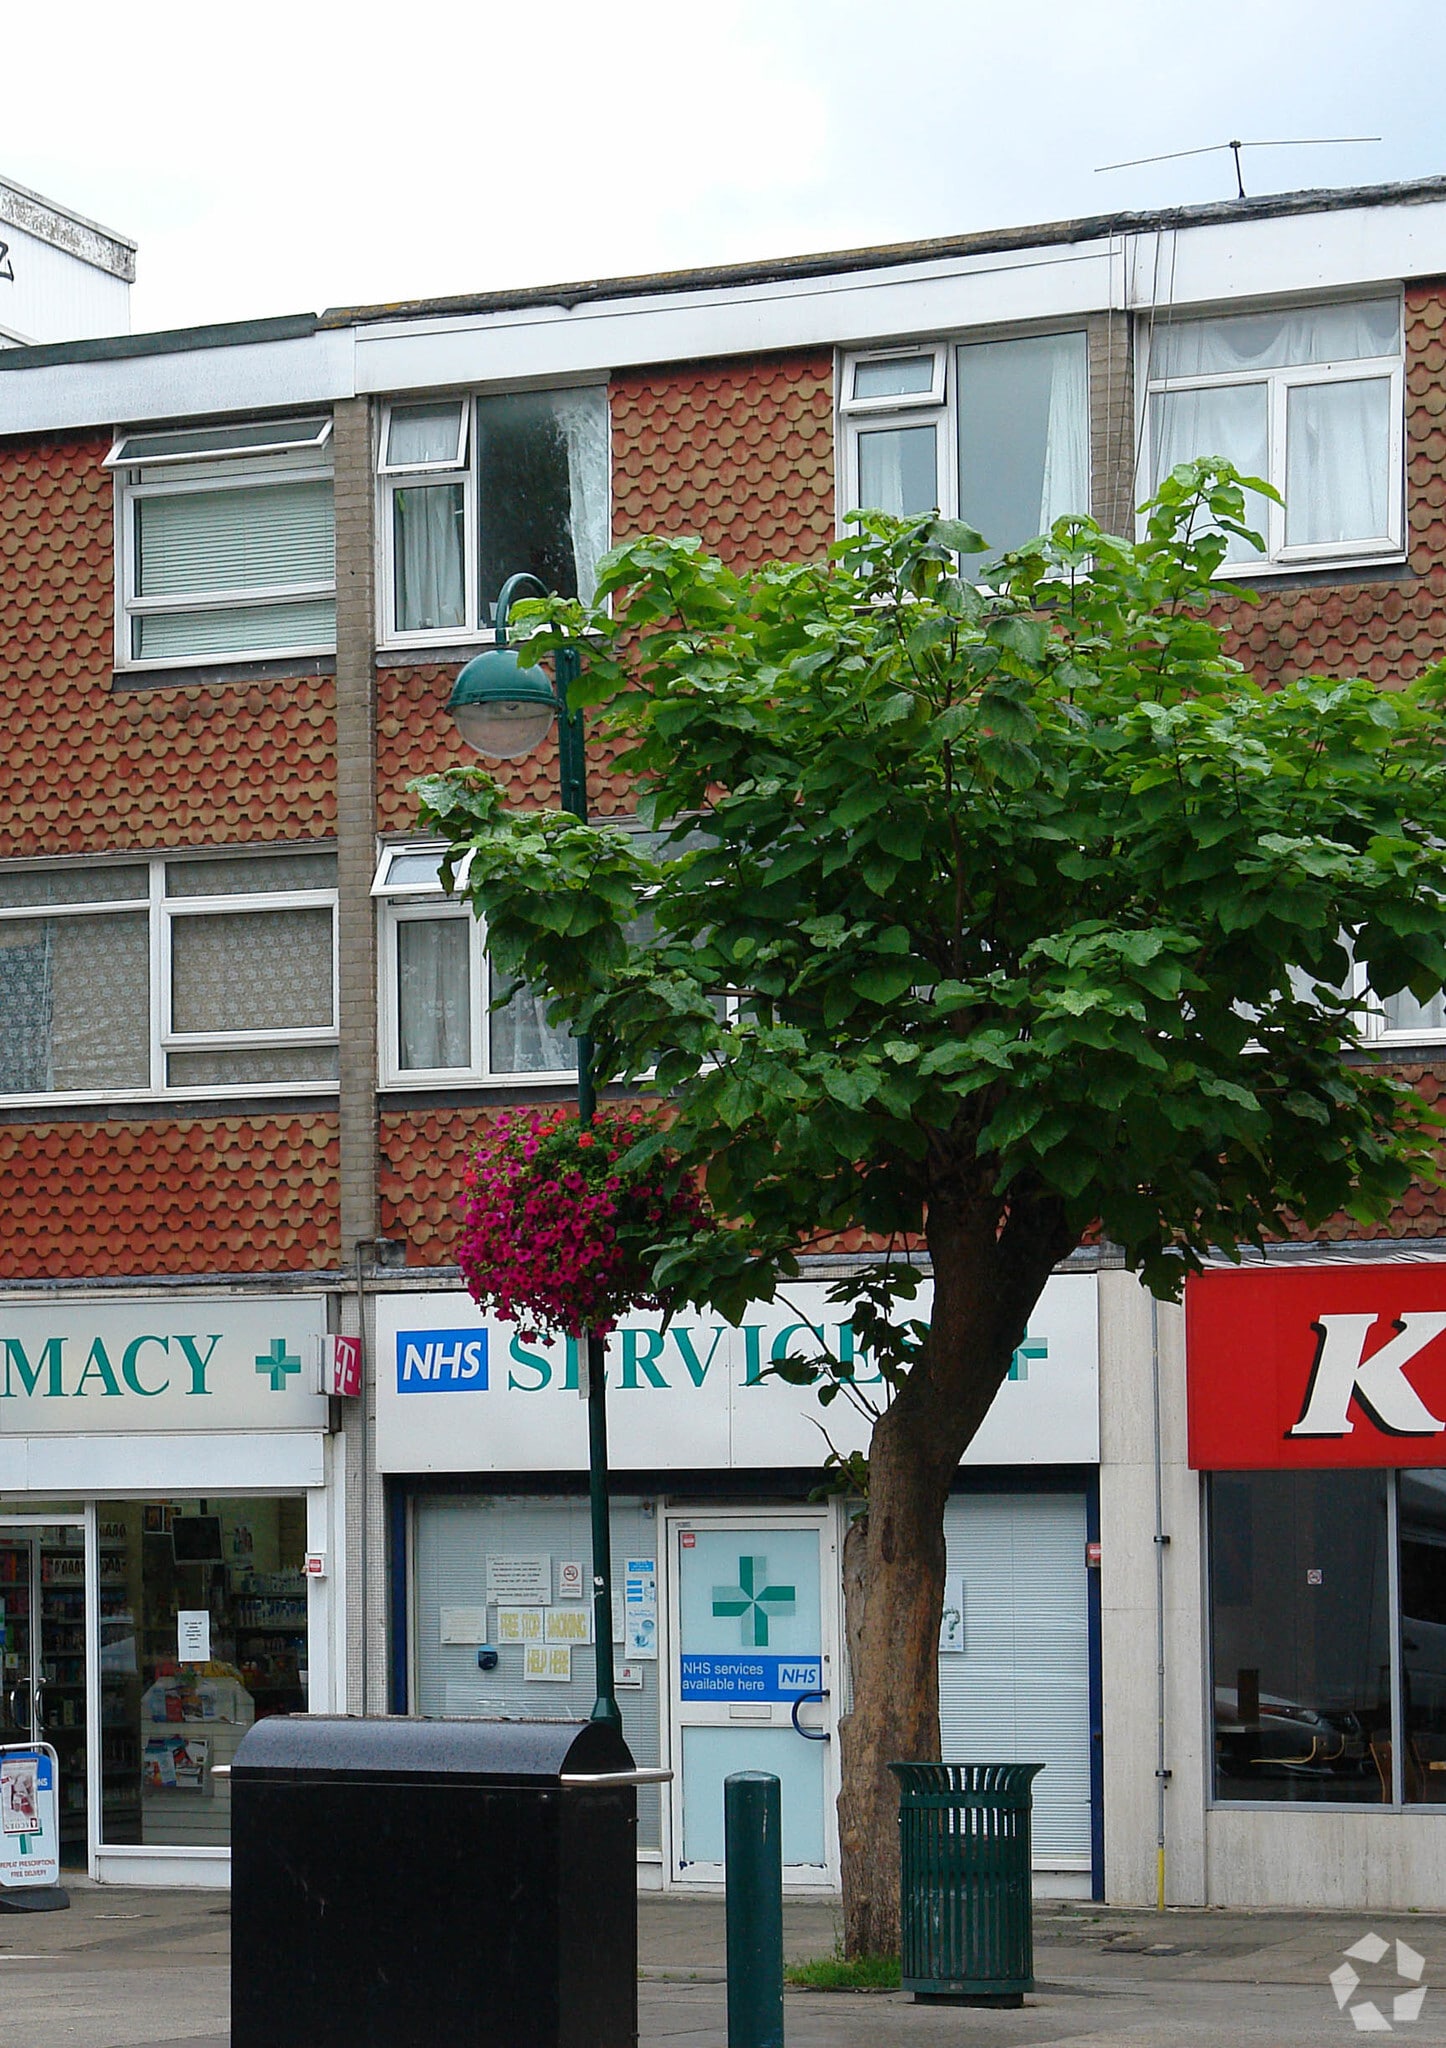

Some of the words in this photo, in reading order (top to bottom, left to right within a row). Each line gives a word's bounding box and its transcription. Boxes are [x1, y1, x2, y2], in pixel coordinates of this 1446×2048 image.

[0, 1334, 223, 1397] MACY
[402, 1341, 482, 1381] NHS
[508, 1322, 931, 1391] SRVICE
[1284, 1311, 1446, 1438] K
[682, 1678, 735, 1691] available
[737, 1679, 765, 1691] here
[683, 1662, 711, 1675] NHS
[714, 1663, 764, 1675] services
[782, 1668, 816, 1684] NHS
